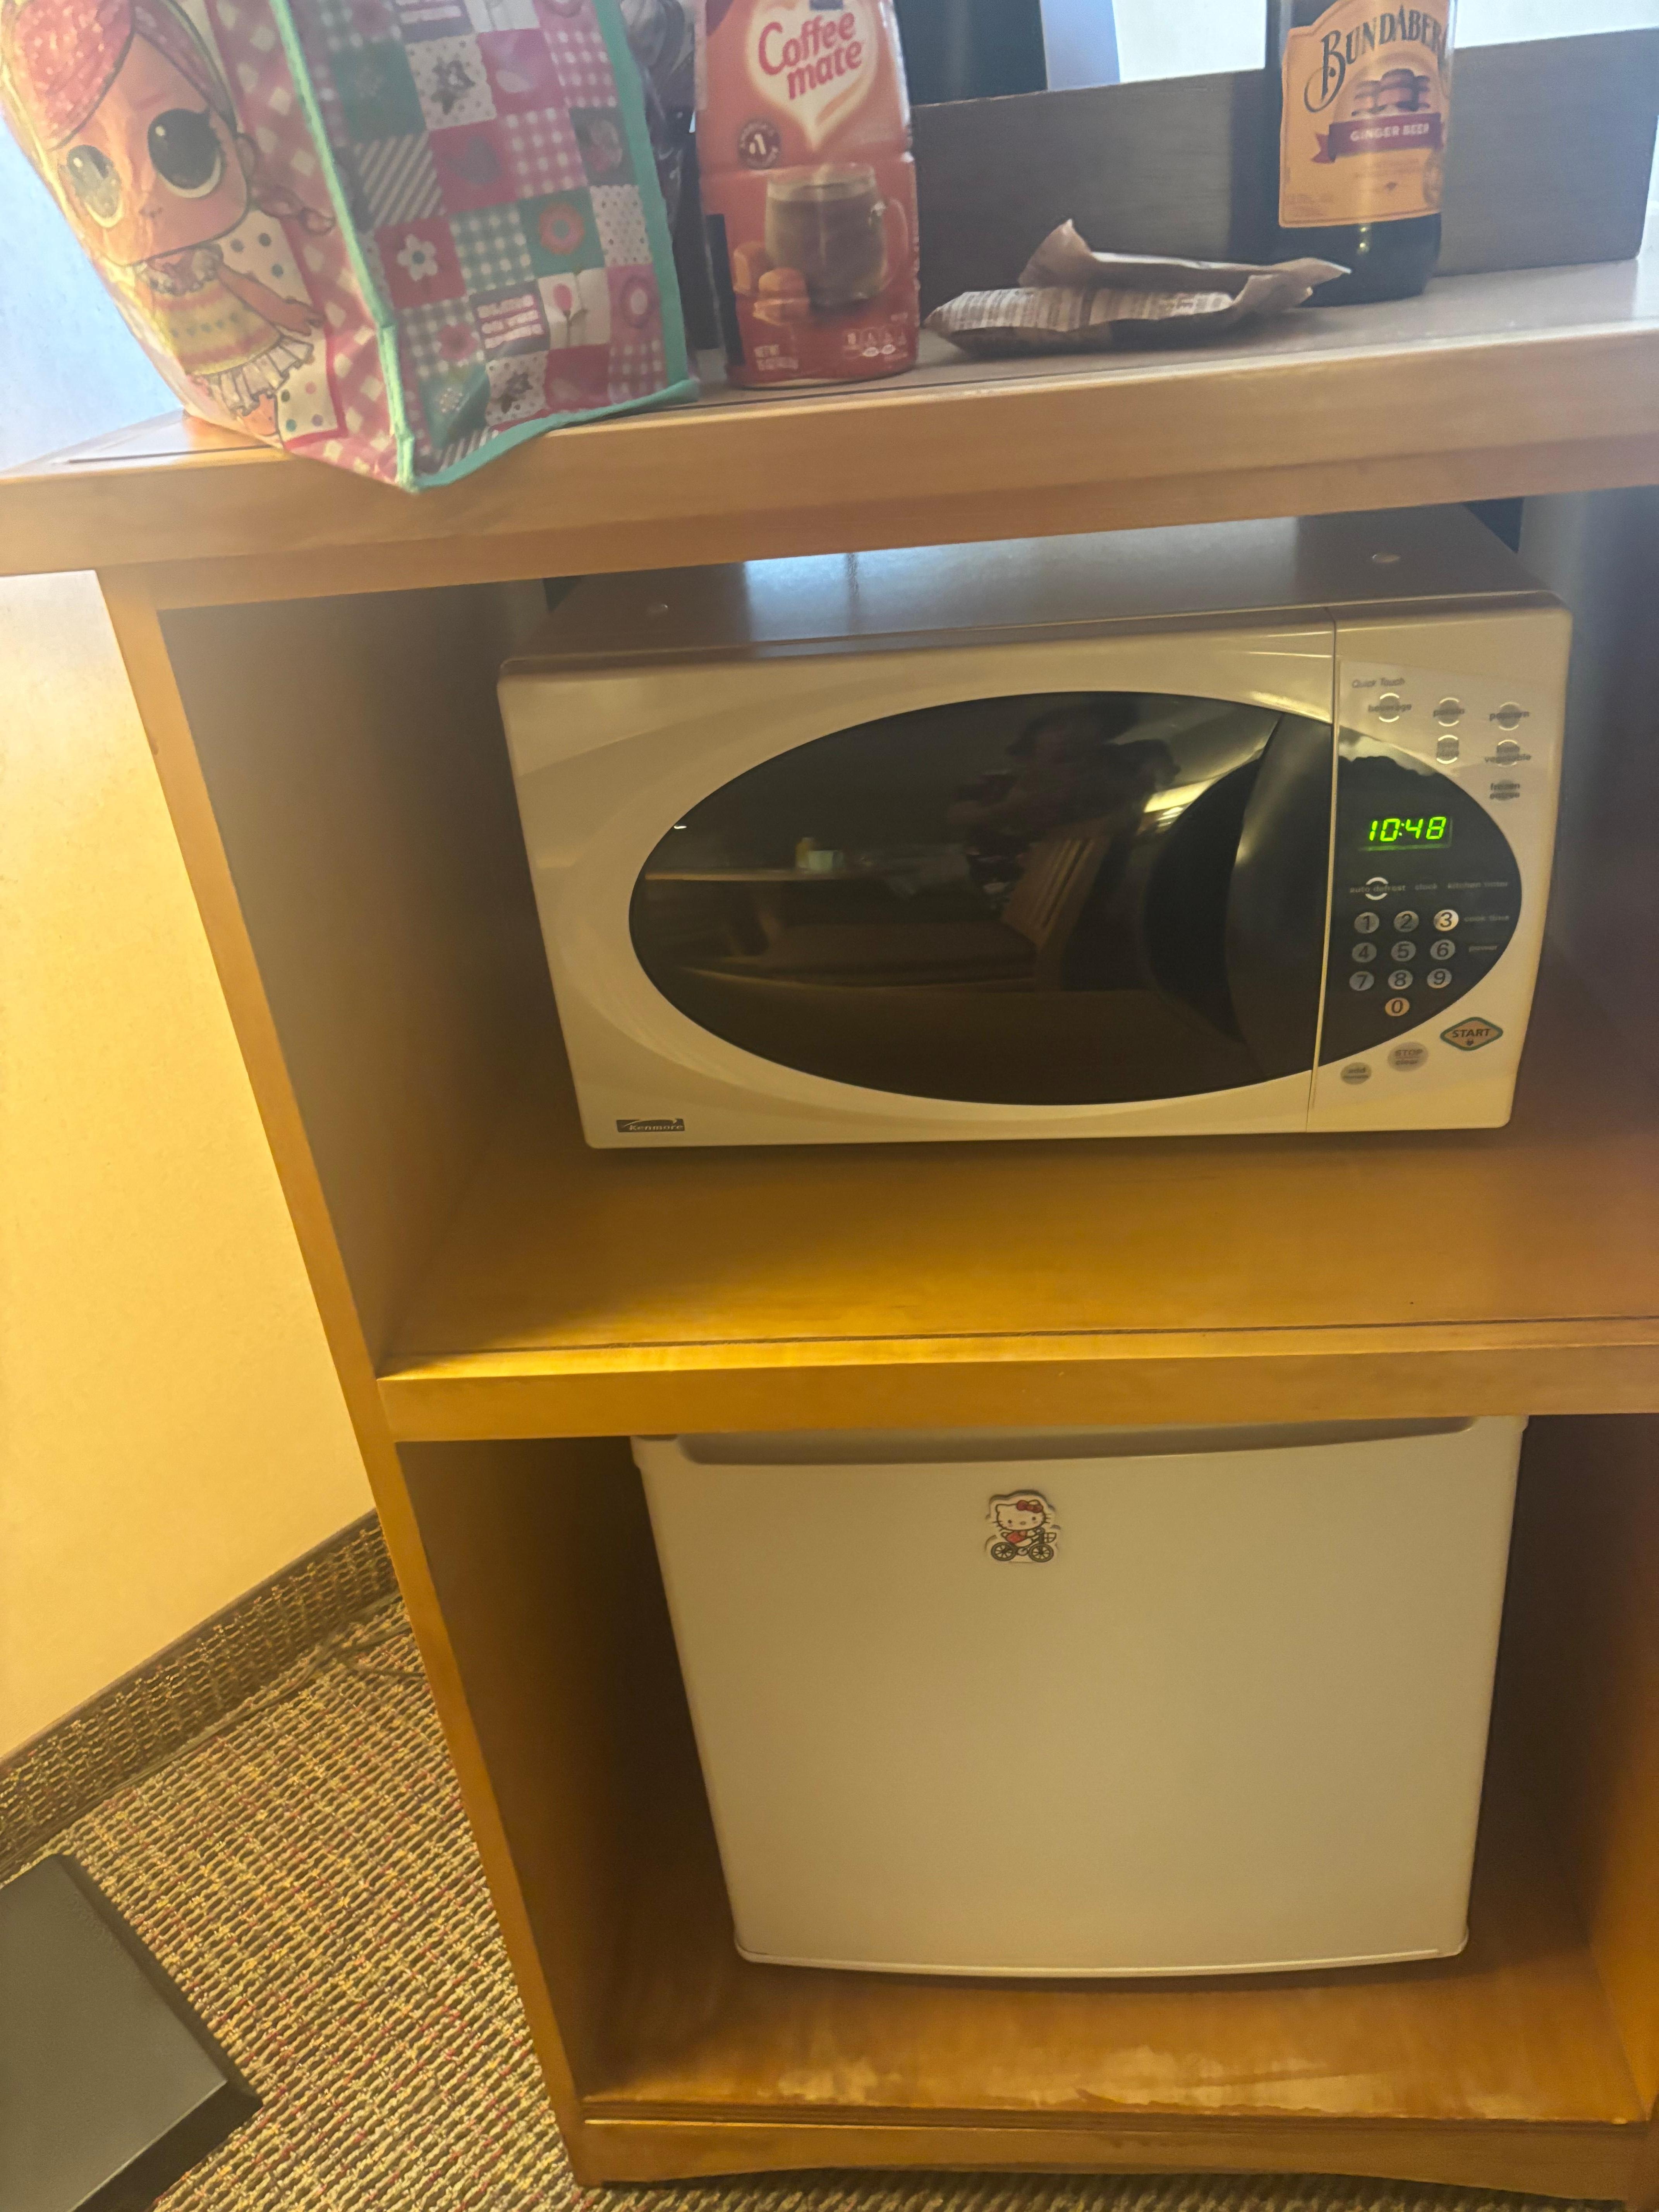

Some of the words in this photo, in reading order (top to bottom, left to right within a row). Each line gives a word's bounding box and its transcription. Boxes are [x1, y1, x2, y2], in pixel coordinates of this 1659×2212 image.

[758, 12, 855, 76] Coffee
[1304, 4, 1443, 113] BUNDABER
[787, 40, 862, 100] mate
[1369, 816, 1446, 842] 10:48
[1364, 915, 1370, 930] 1
[1400, 914, 1412, 929] 2
[1440, 912, 1453, 928] 3
[1359, 945, 1369, 959] 4
[1397, 943, 1409, 958] 5
[1437, 942, 1449, 957] 6
[1357, 975, 1368, 989] 7
[1394, 972, 1407, 987] 8
[1433, 971, 1446, 985] 9
[1392, 1000, 1403, 1014] 0
[1452, 1028, 1491, 1038] START
[1395, 1049, 1423, 1057] STOP
